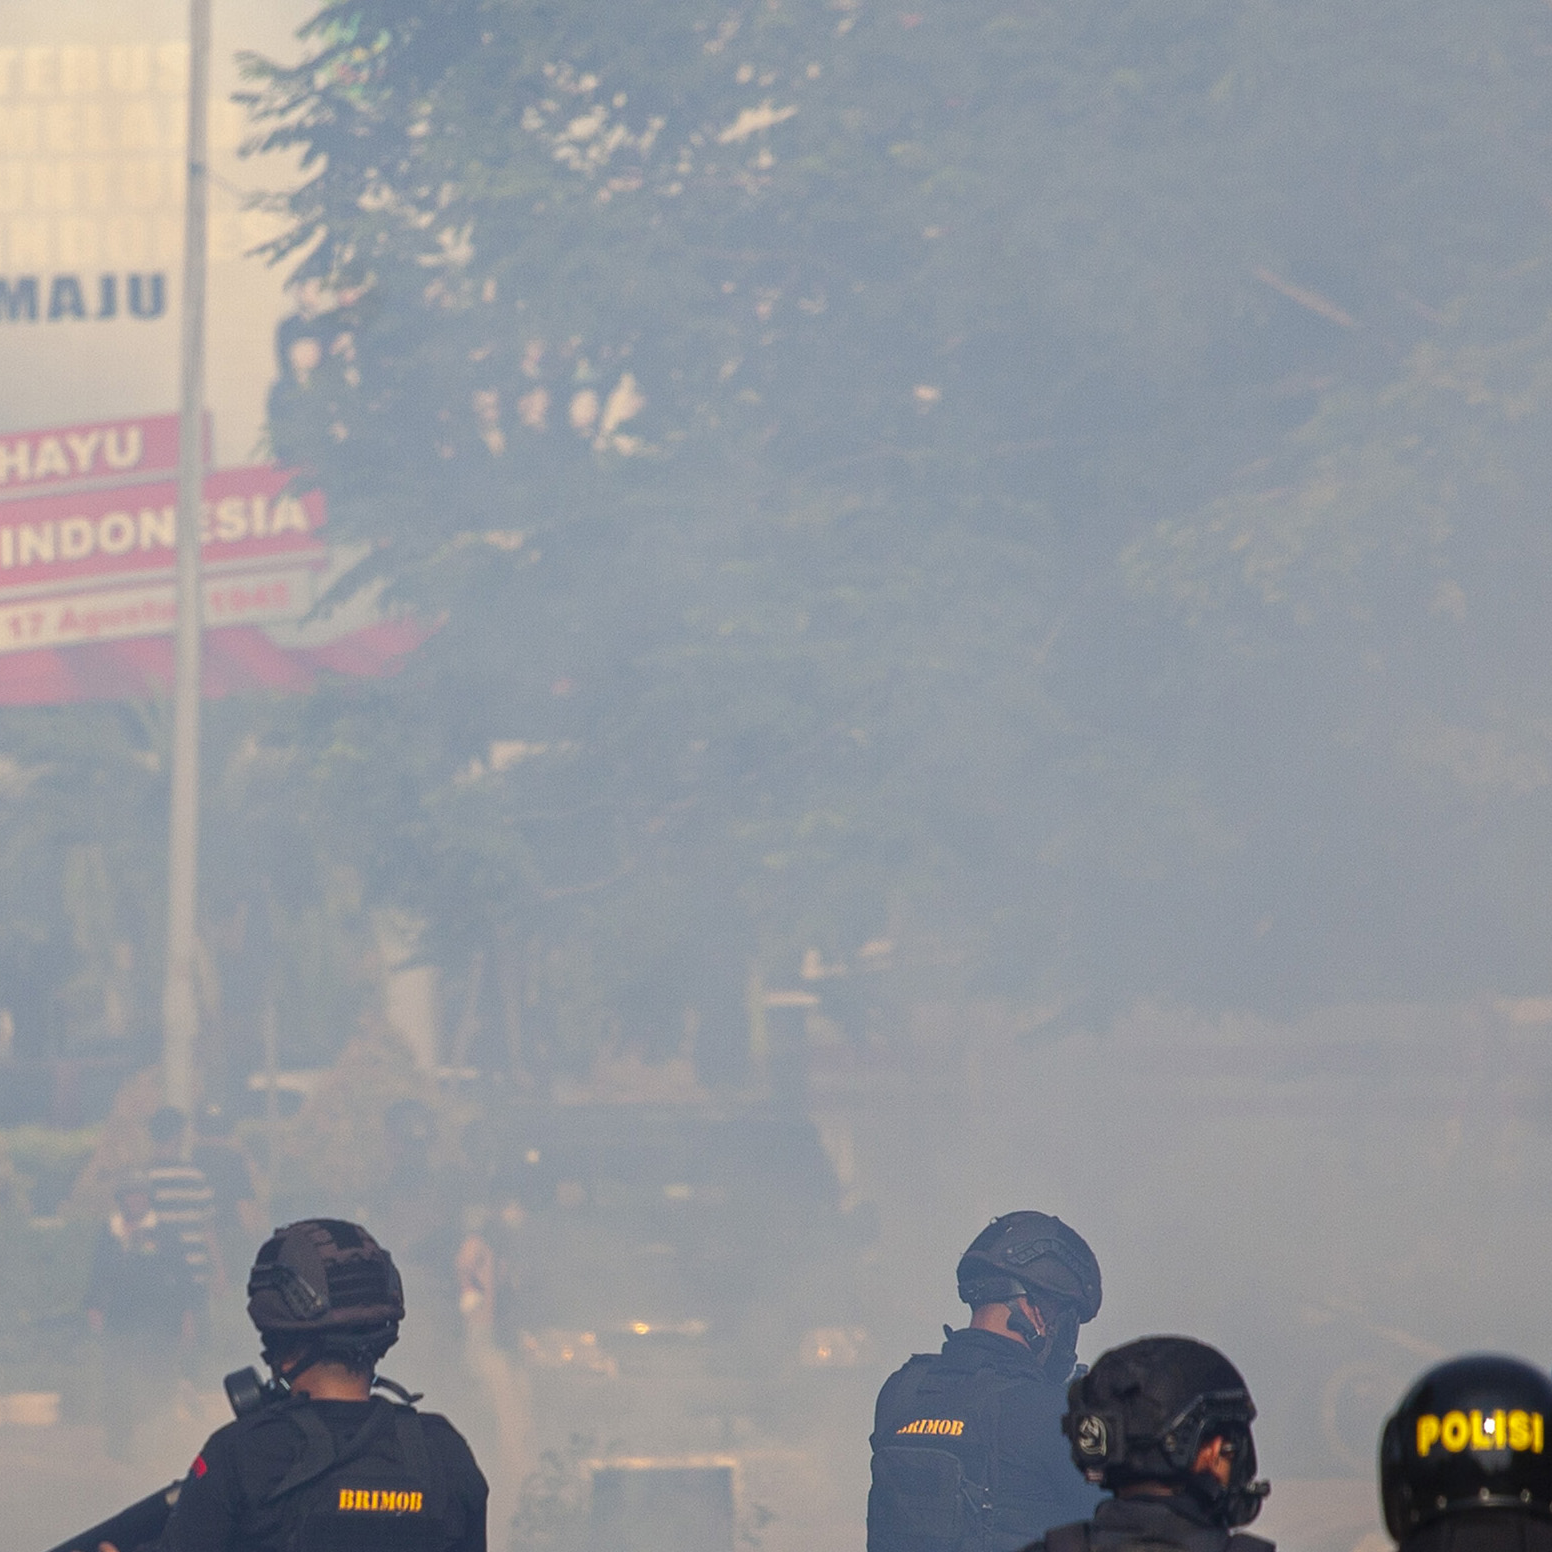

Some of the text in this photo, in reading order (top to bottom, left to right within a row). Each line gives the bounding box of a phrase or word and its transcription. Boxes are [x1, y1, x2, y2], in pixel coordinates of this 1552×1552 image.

[896, 1418, 965, 1436] RIMOB
[1415, 1408, 1544, 1457] POLISI
[338, 1488, 423, 1512] BRIMOB
